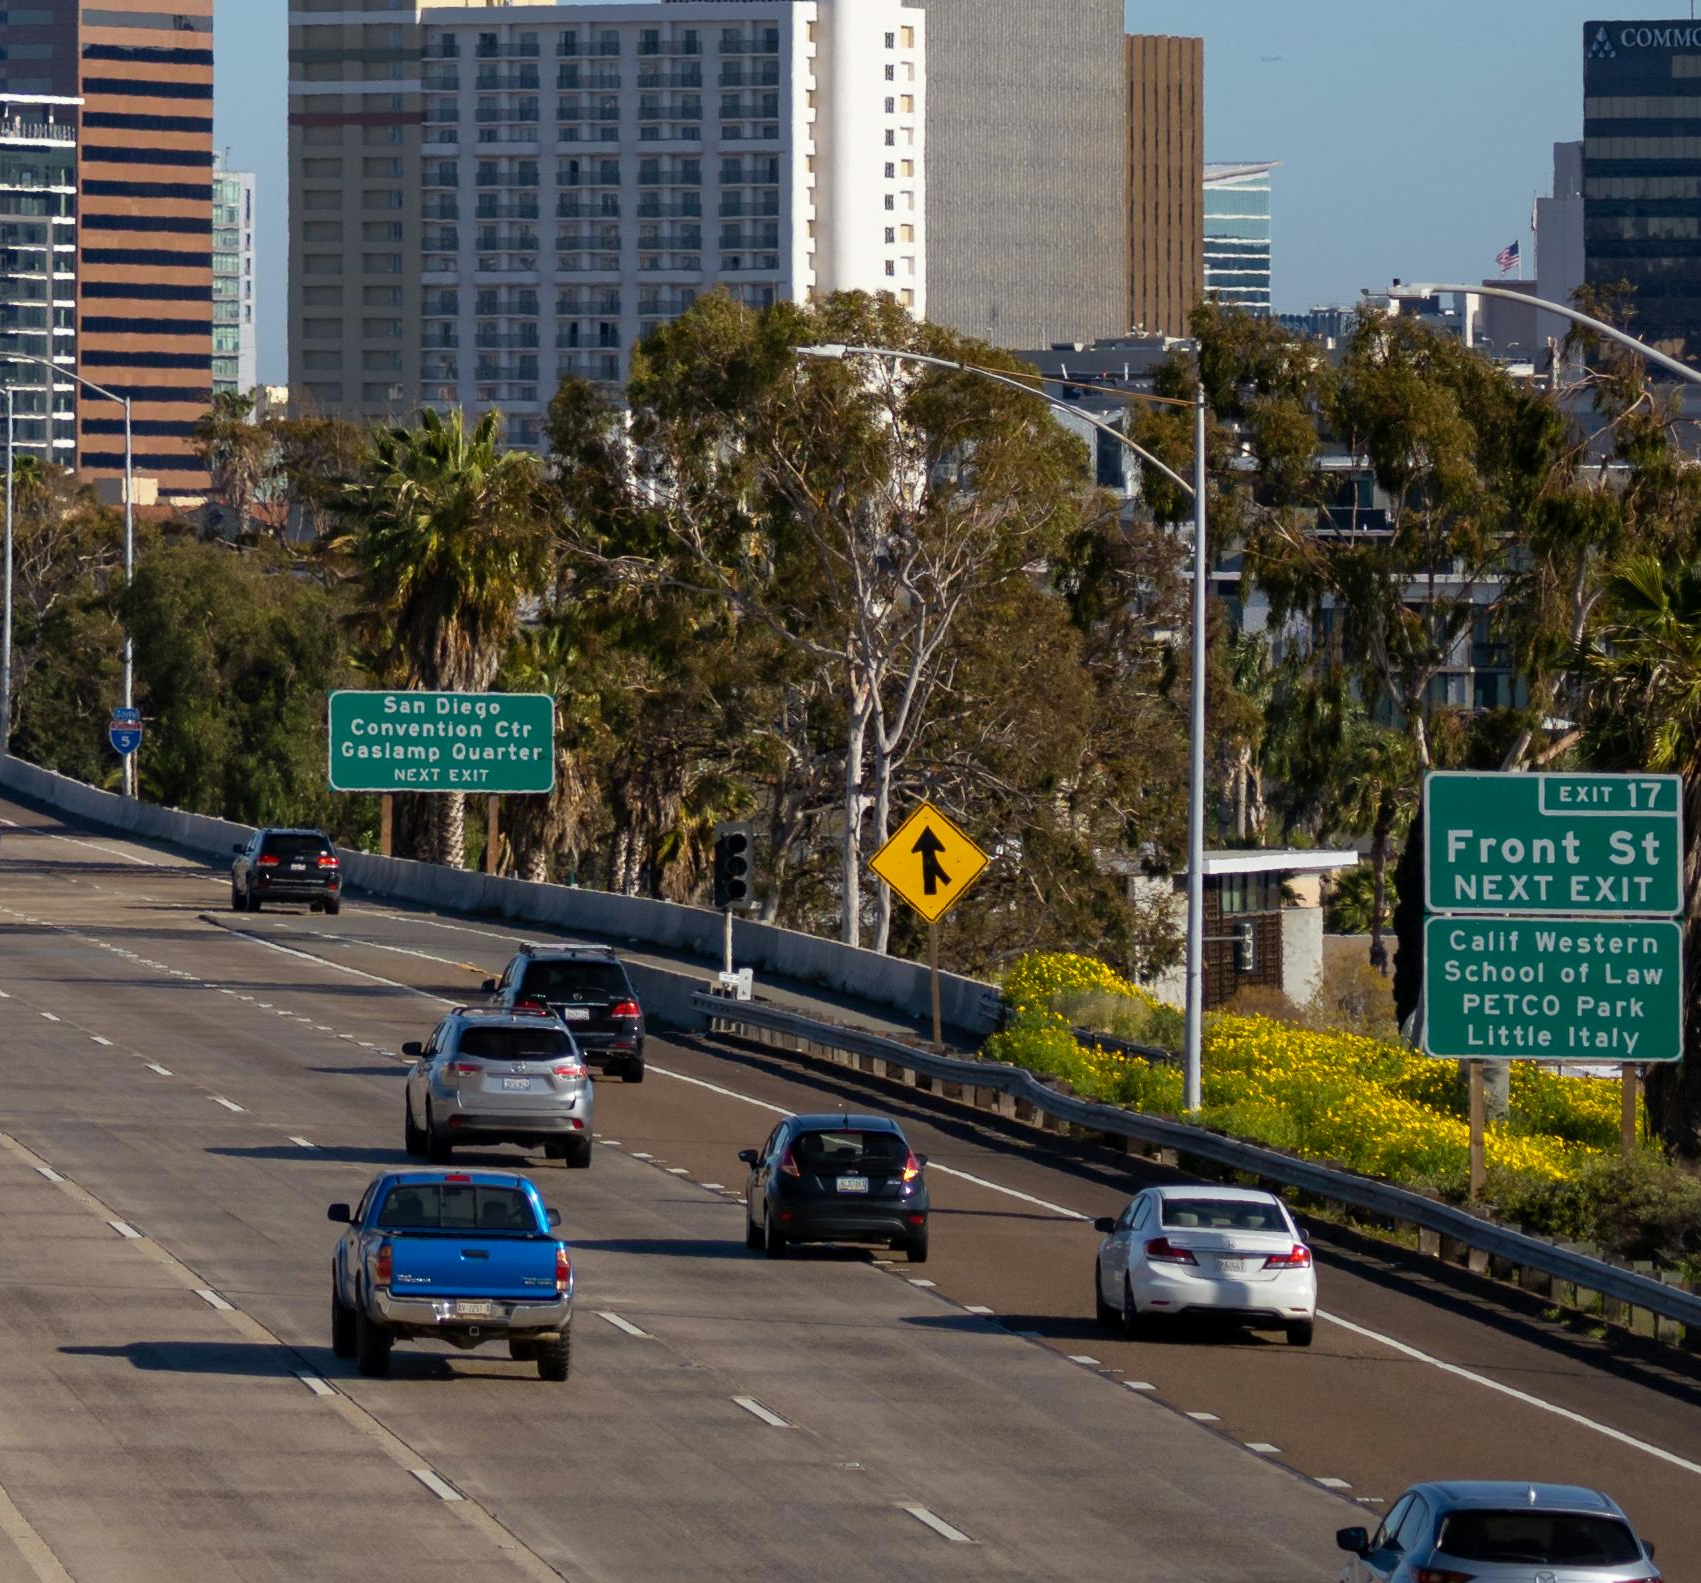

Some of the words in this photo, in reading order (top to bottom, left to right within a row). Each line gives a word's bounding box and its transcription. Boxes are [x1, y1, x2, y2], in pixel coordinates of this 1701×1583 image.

[384, 696, 425, 714] San
[436, 697, 501, 719] Diego
[351, 718, 482, 737] Convention
[495, 721, 532, 738] Ctr
[121, 735, 131, 747] 5
[341, 741, 441, 763] Gaslamp
[452, 742, 543, 761] Quarter
[394, 768, 441, 782] NEXT
[449, 769, 489, 782] EXIT
[1560, 786, 1613, 803] EXIT
[1627, 782, 1662, 808] 17
[1447, 829, 1580, 864] Front
[1609, 830, 1660, 866] St
[1455, 875, 1554, 901] NEXT
[1570, 876, 1653, 902] EXIT
[1450, 930, 1519, 953] Calif
[1535, 931, 1658, 955] Western
[1444, 960, 1544, 983] School
[1560, 963, 1589, 983] of
[1605, 964, 1664, 985] Law
[1463, 994, 1560, 1016] PETCO
[1577, 996, 1644, 1018] Park
[1468, 1025, 1552, 1047] Little
[1569, 1026, 1640, 1055] Italy
